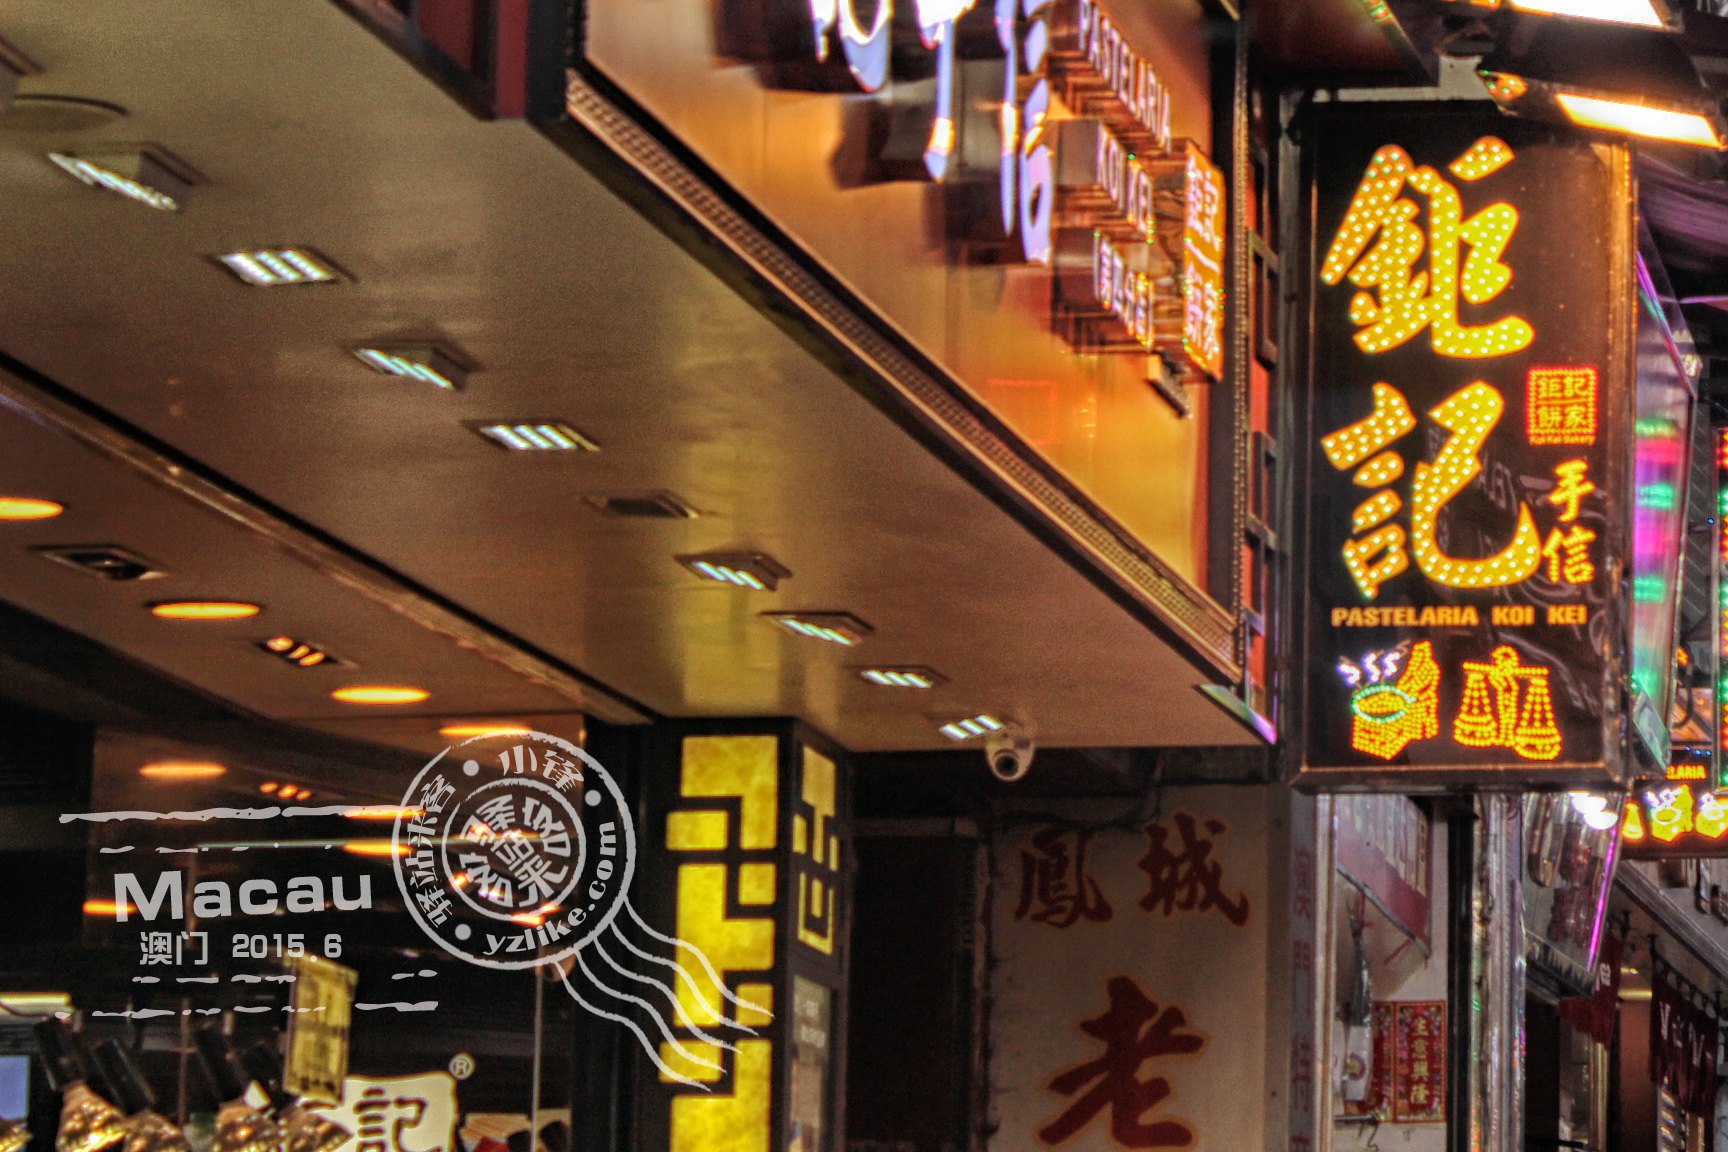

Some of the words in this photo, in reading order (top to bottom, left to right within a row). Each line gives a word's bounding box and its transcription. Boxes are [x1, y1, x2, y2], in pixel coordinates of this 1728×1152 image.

[1320, 136, 1543, 599] 鉅記
[1537, 376, 1589, 397] 鉅記
[1537, 405, 1588, 429] 餅家
[1546, 457, 1597, 584] 手信
[1331, 604, 1480, 627] PASTELARIA
[1491, 604, 1535, 626] KOI
[1547, 604, 1588, 626] KEI
[1038, 975, 1205, 1149] 老
